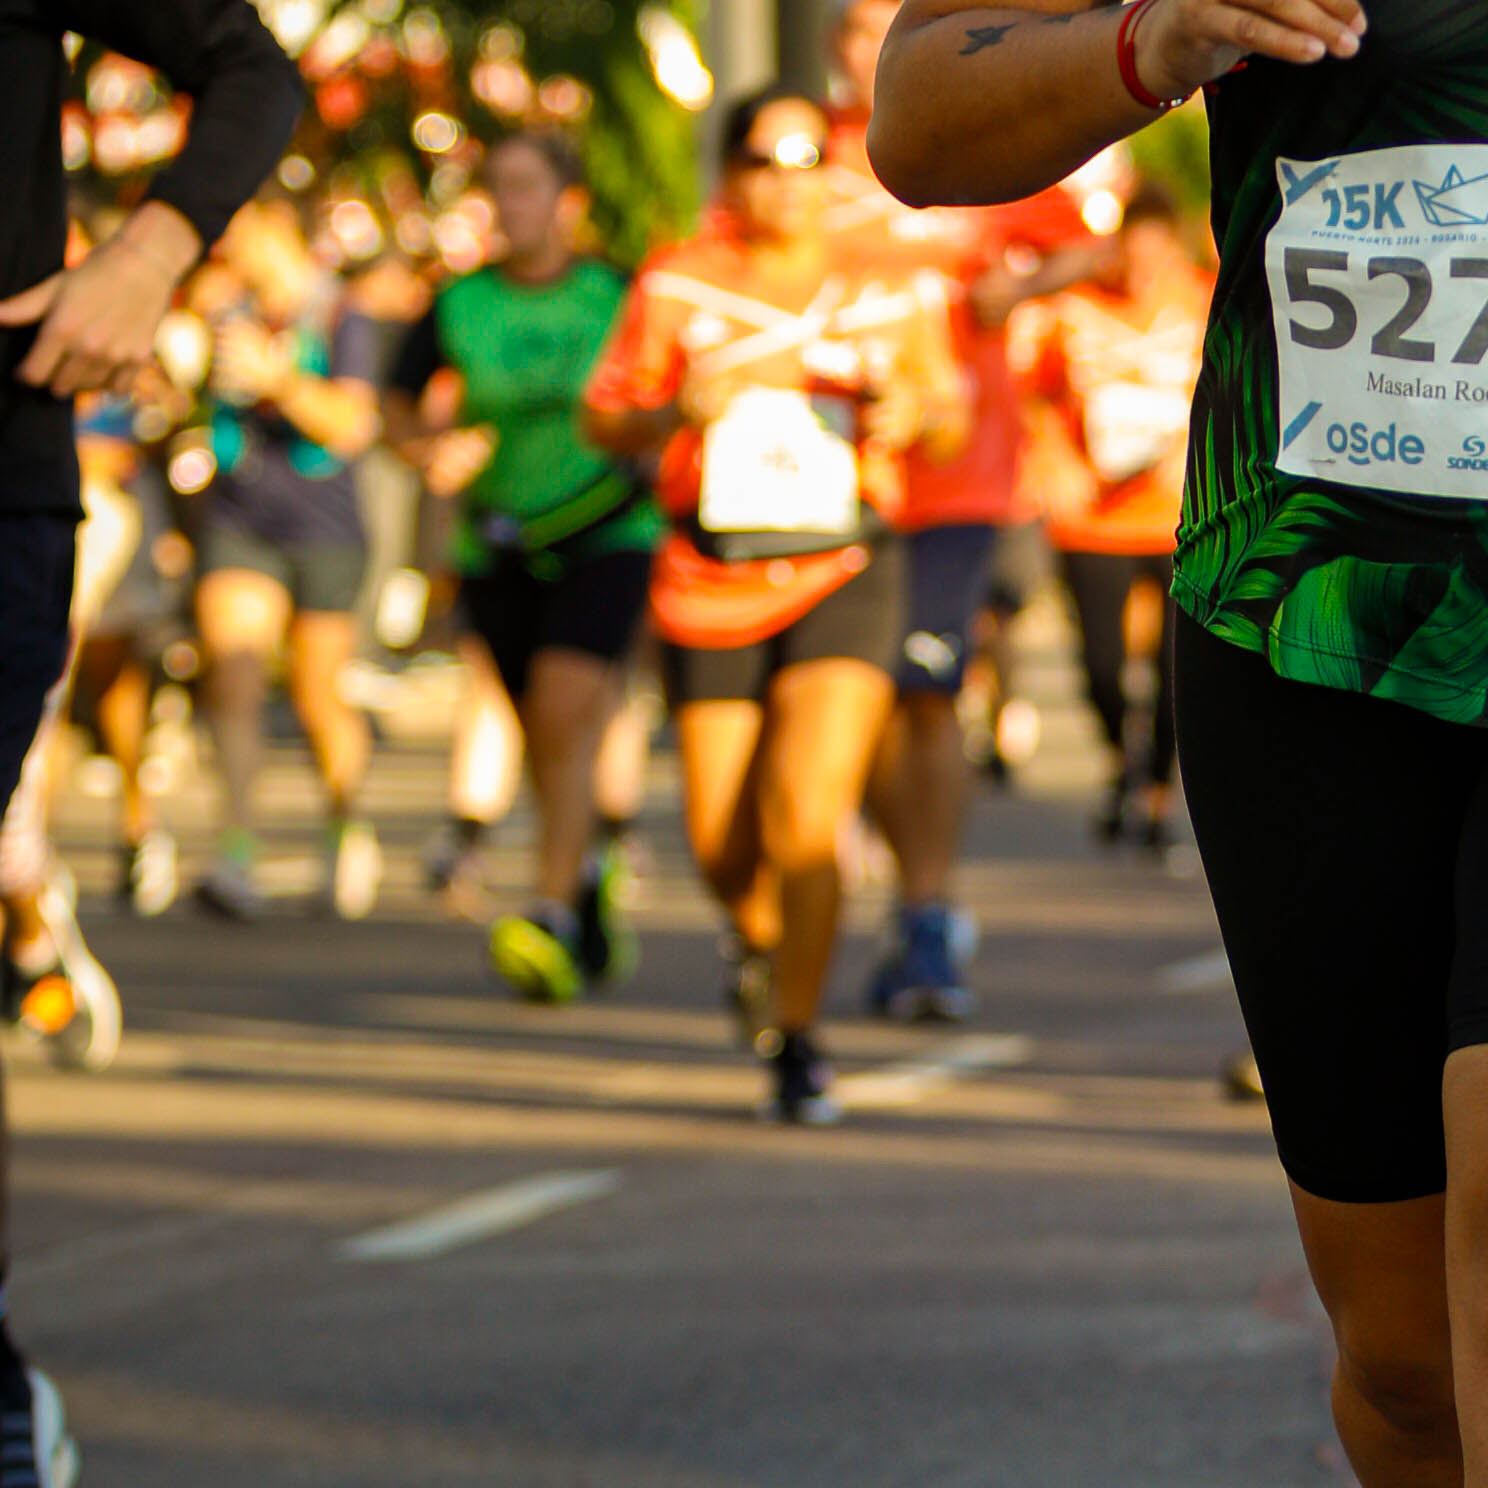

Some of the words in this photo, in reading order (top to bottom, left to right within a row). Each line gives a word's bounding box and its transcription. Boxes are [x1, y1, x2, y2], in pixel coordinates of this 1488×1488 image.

[1321, 180, 1406, 230] 15K
[1431, 233, 1477, 243] ROSARIO
[1366, 371, 1446, 400] Masalan
[1326, 421, 1425, 465] osde
